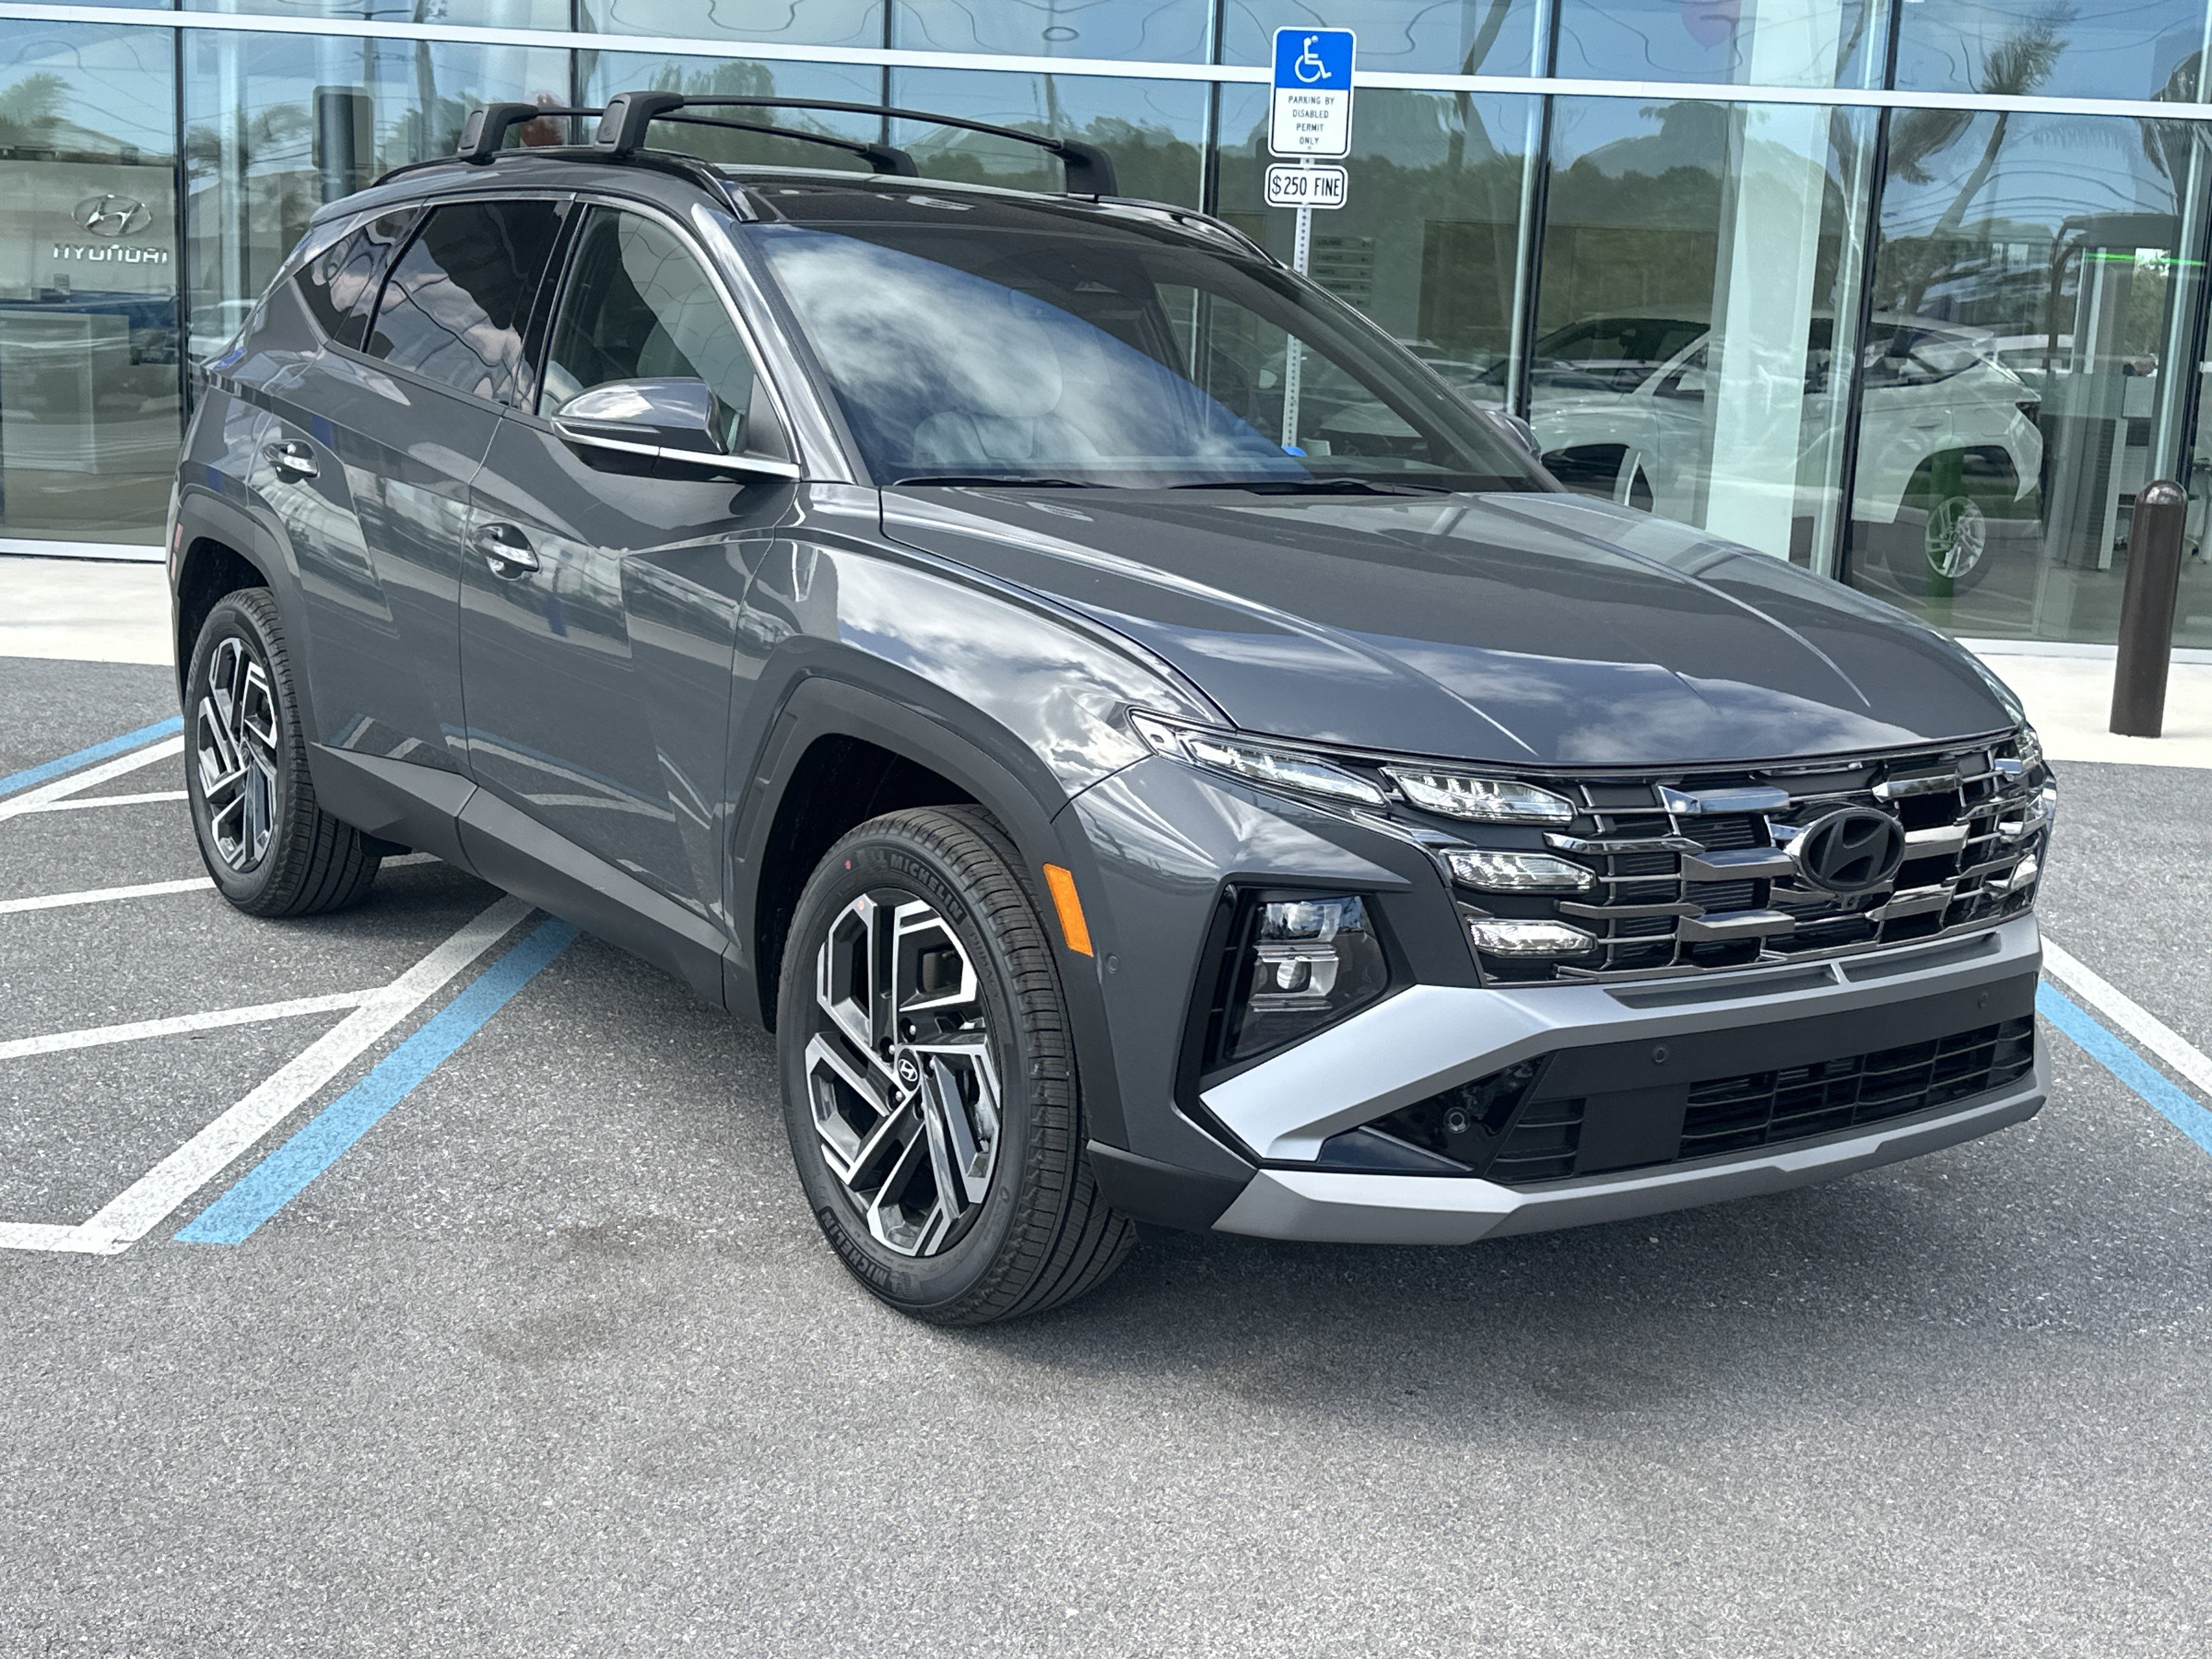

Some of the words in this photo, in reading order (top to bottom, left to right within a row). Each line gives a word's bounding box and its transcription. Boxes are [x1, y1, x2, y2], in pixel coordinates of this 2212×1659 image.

[1288, 95, 1321, 104] PARKING
[1325, 96, 1335, 105] BY
[1293, 109, 1329, 119] DISABLED
[1296, 122, 1324, 132] PERMIT
[1299, 136, 1319, 145] ONLY
[1272, 174, 1307, 196] $250
[1314, 177, 1340, 196] FINE
[53, 243, 167, 264] HYUNDAI
[890, 854, 963, 921] MICHELIN
[820, 1211, 890, 1287] MICHELIN
